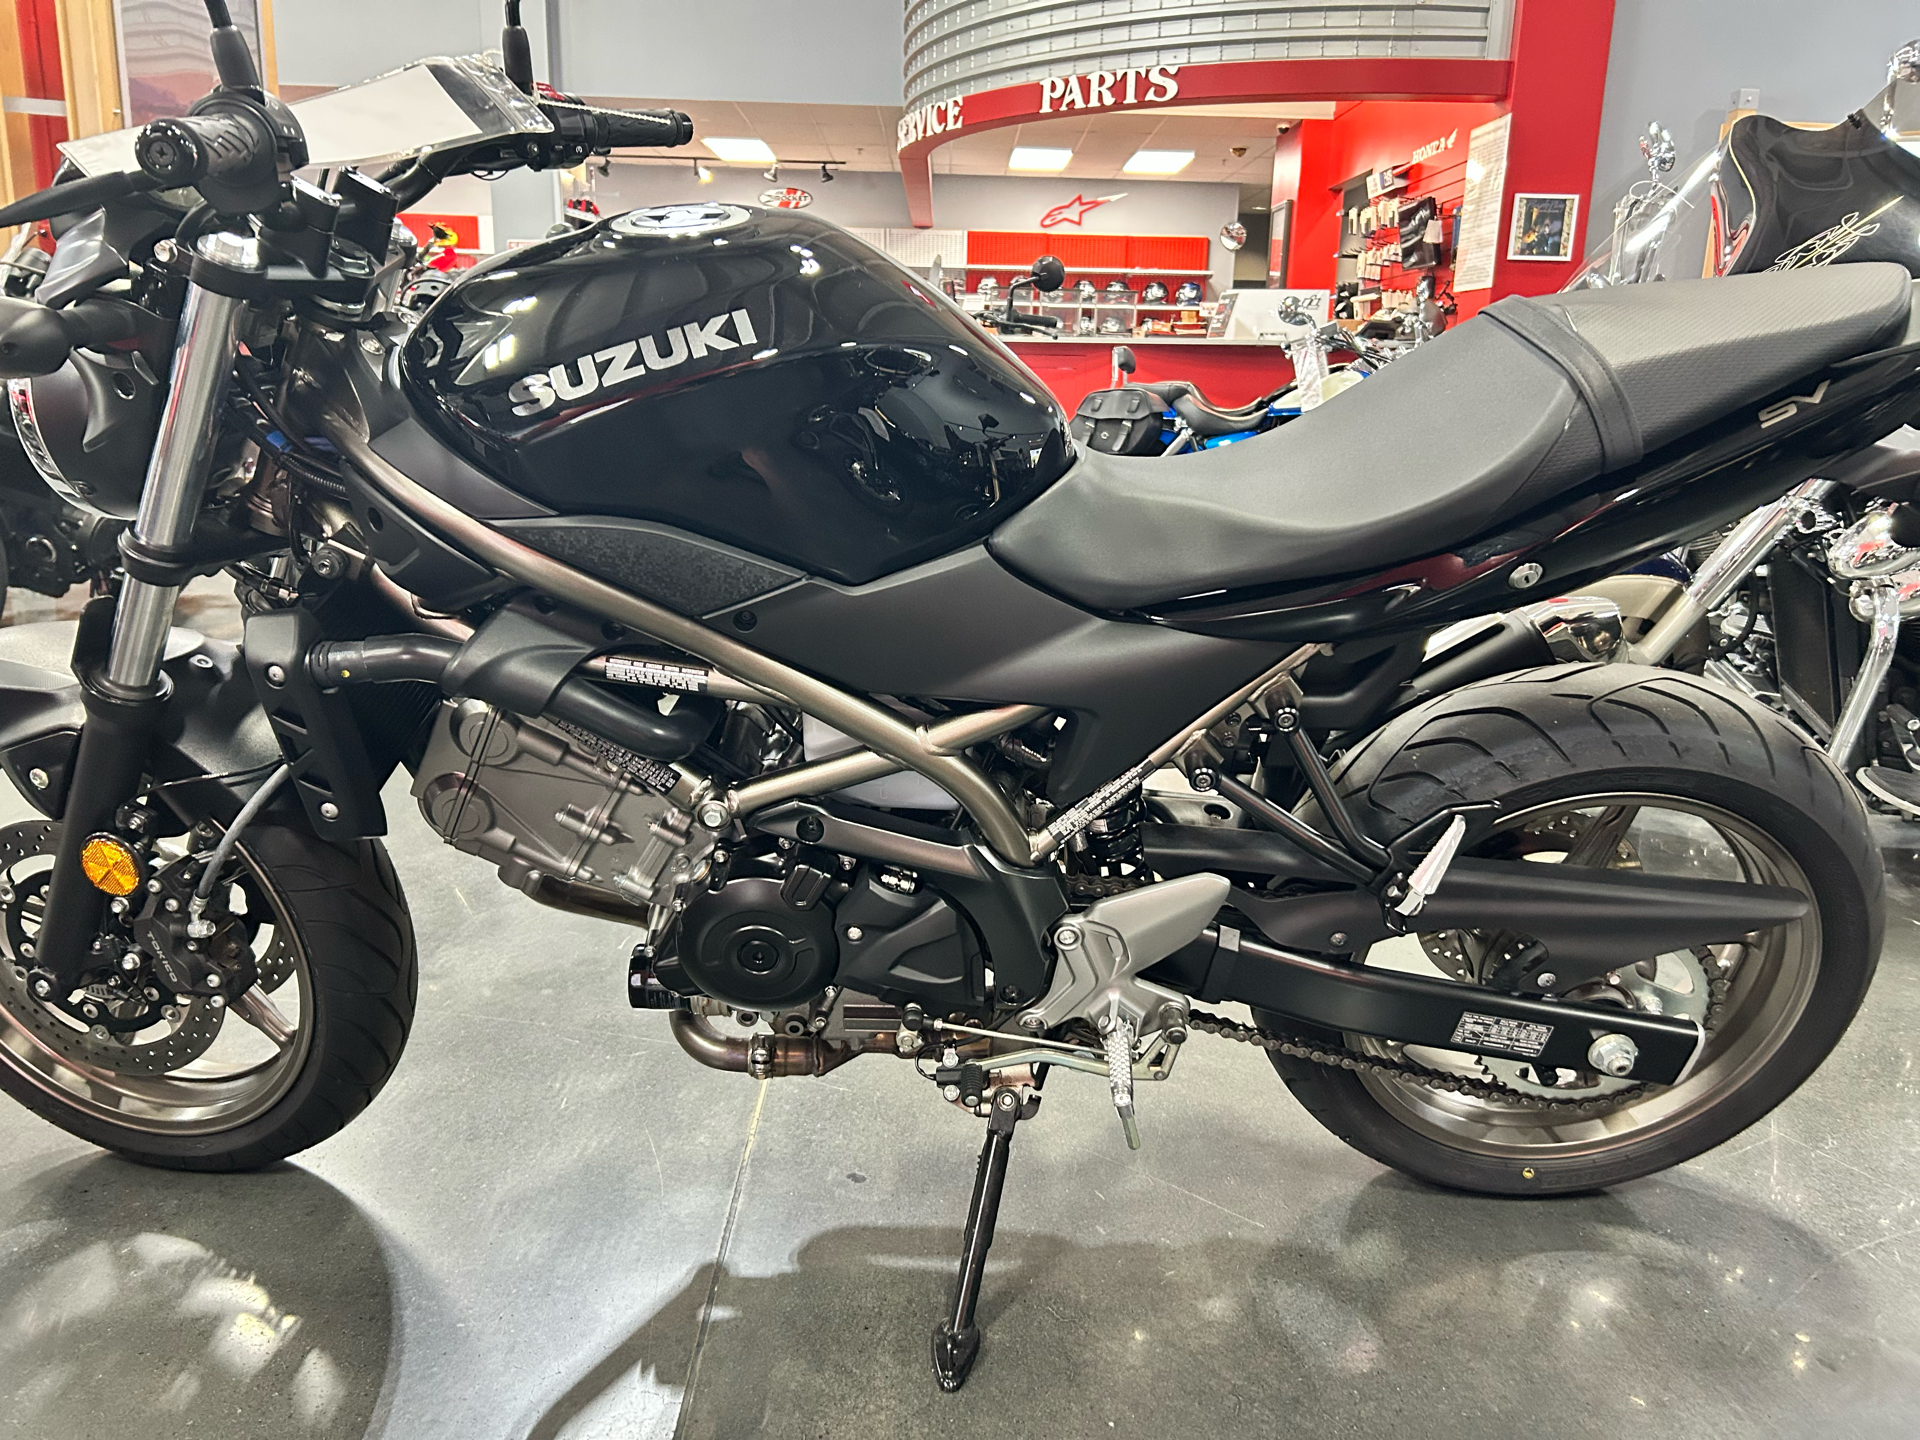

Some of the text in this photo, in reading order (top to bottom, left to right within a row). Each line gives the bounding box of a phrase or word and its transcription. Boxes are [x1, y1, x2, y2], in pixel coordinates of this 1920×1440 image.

[1039, 64, 1182, 114] PARTS
[896, 95, 964, 152] SERVICE
[508, 309, 759, 417] SUZUKI
[1758, 379, 1831, 429] SV
[145, 930, 178, 984] TOKICO
